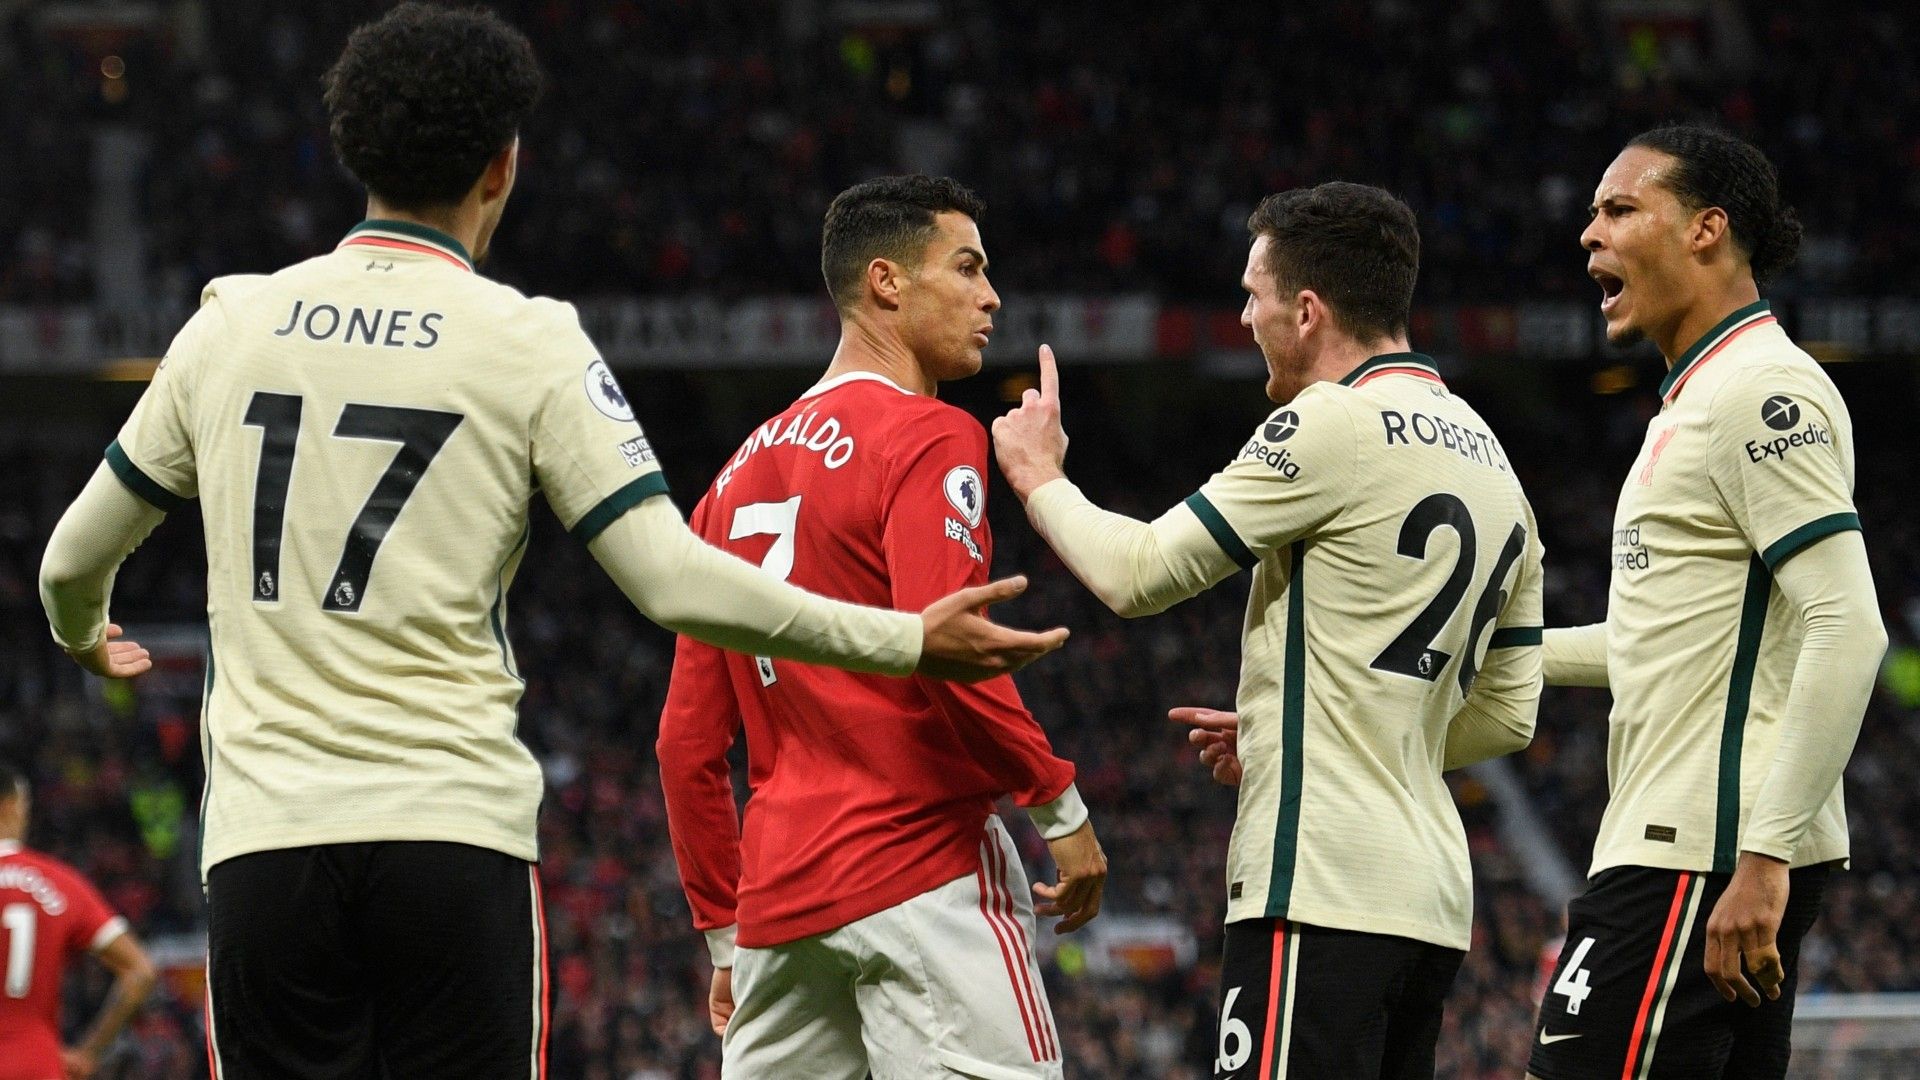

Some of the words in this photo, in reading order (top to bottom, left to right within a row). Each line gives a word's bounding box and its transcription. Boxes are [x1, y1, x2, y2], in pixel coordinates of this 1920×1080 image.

[274, 300, 444, 349] JONES
[716, 411, 854, 498] RONALDO
[1243, 441, 1301, 479] pedia
[1381, 410, 1507, 472] ROBERTS
[1745, 423, 1830, 464] Expedia
[242, 391, 465, 614] 17
[729, 495, 802, 688] 7
[1369, 493, 1526, 700] 26
[1553, 937, 1596, 1016] 4
[1214, 986, 1252, 1075] 6
